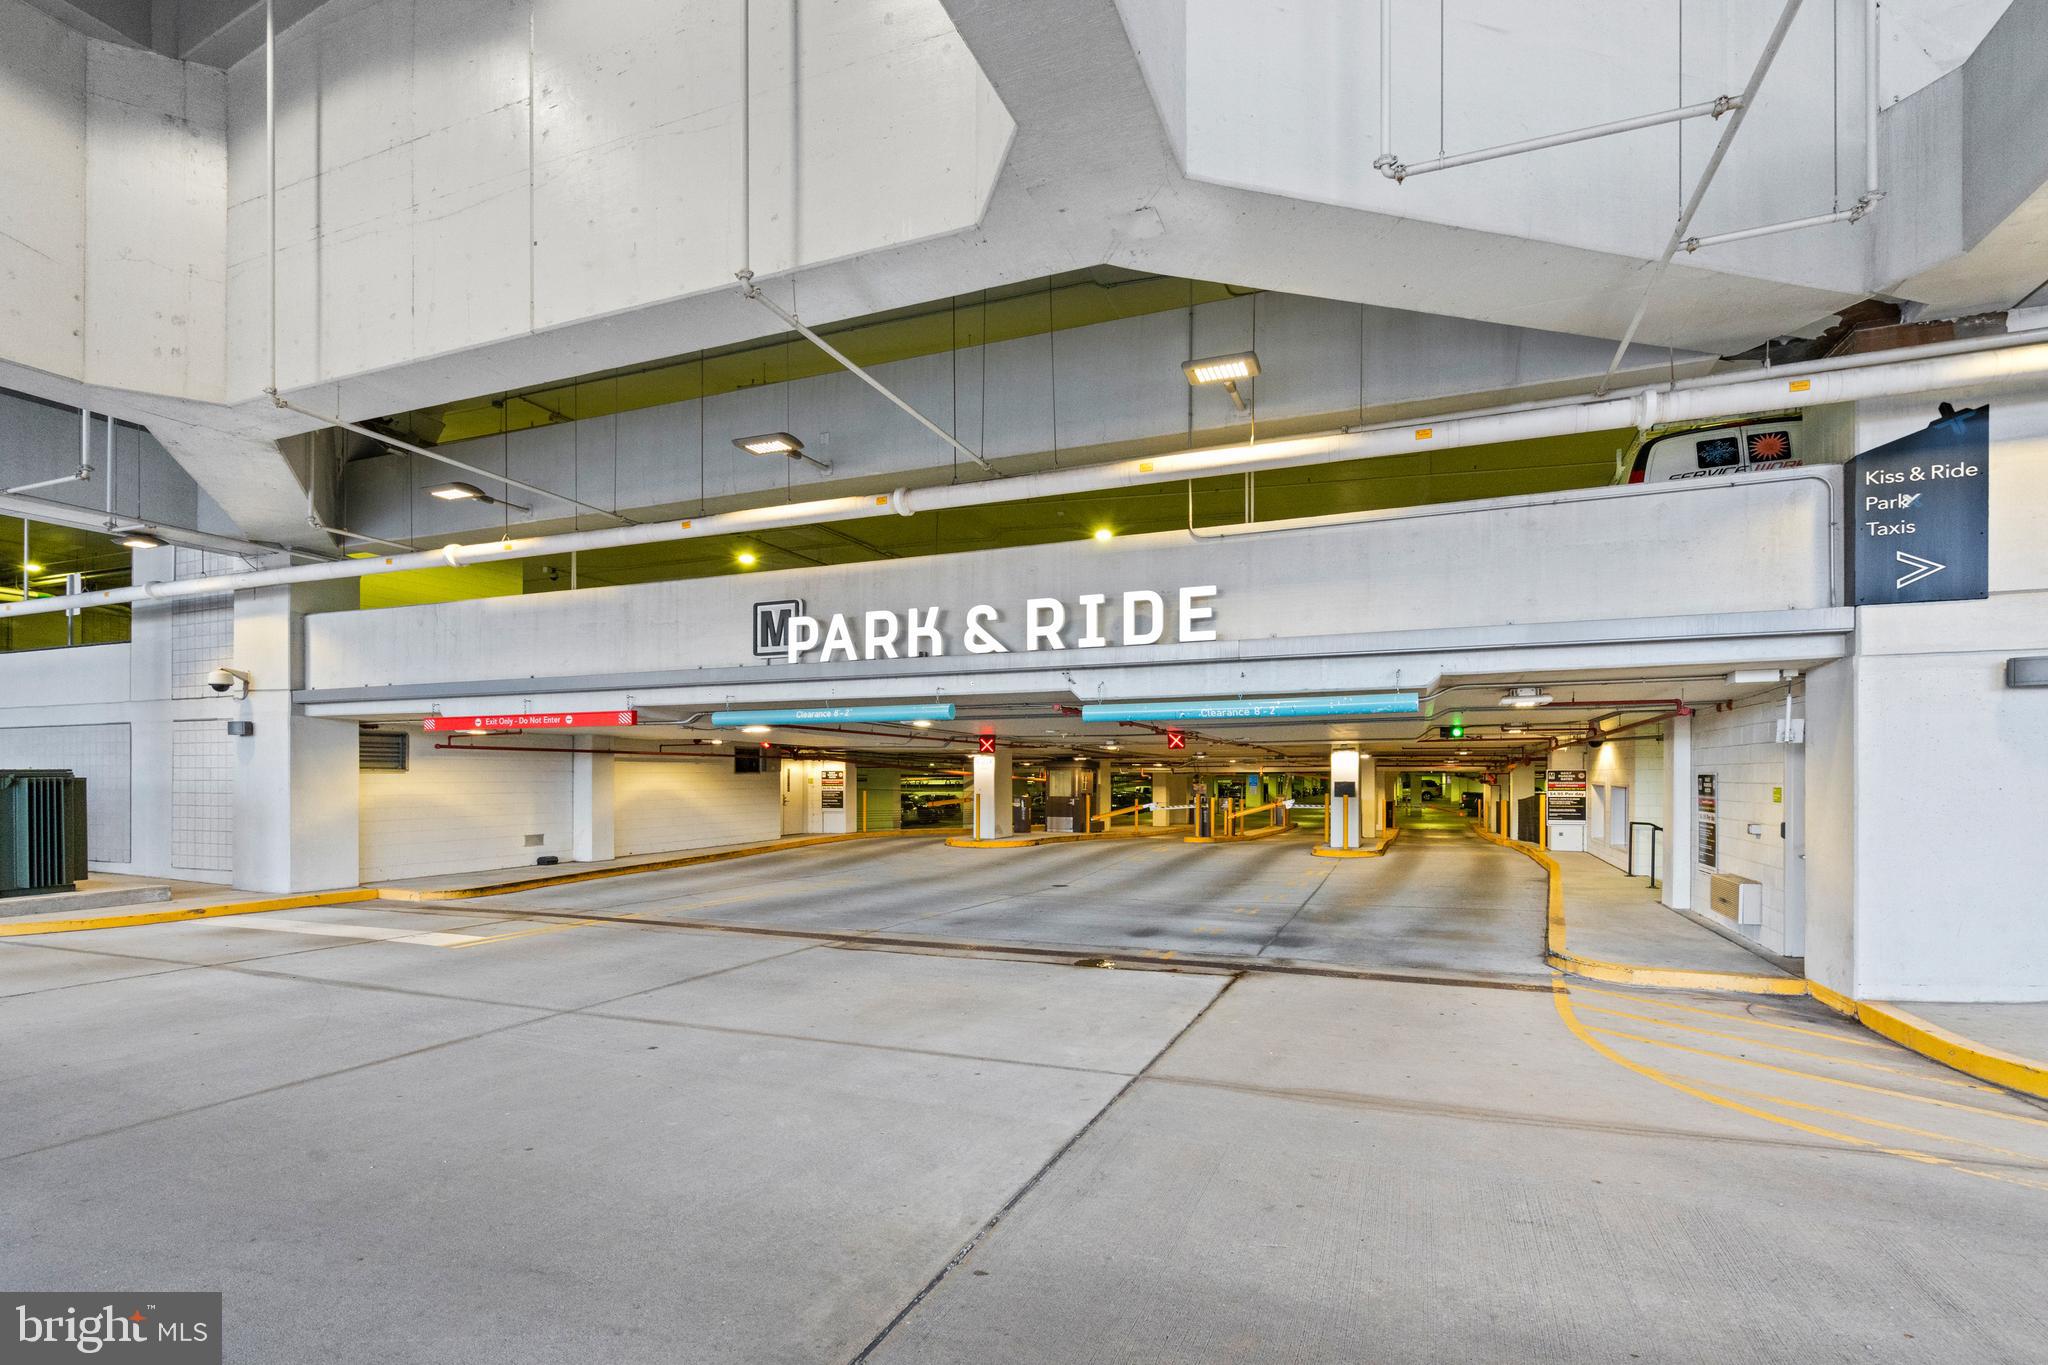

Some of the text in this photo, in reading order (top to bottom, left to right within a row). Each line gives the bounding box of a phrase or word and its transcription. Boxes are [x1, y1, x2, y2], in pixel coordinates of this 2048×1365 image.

[1866, 462, 1978, 485] Kiss & Ride
[1866, 494, 1909, 511] Park
[1866, 520, 1916, 536] Taxis
[788, 585, 1217, 664] PARK & RIDE
[796, 710, 832, 719] Clearance
[1200, 708, 1250, 717] Clearance
[485, 718, 498, 726] Exit
[499, 717, 514, 727] Only
[530, 716, 541, 724] Not
[544, 716, 560, 724] Enter
